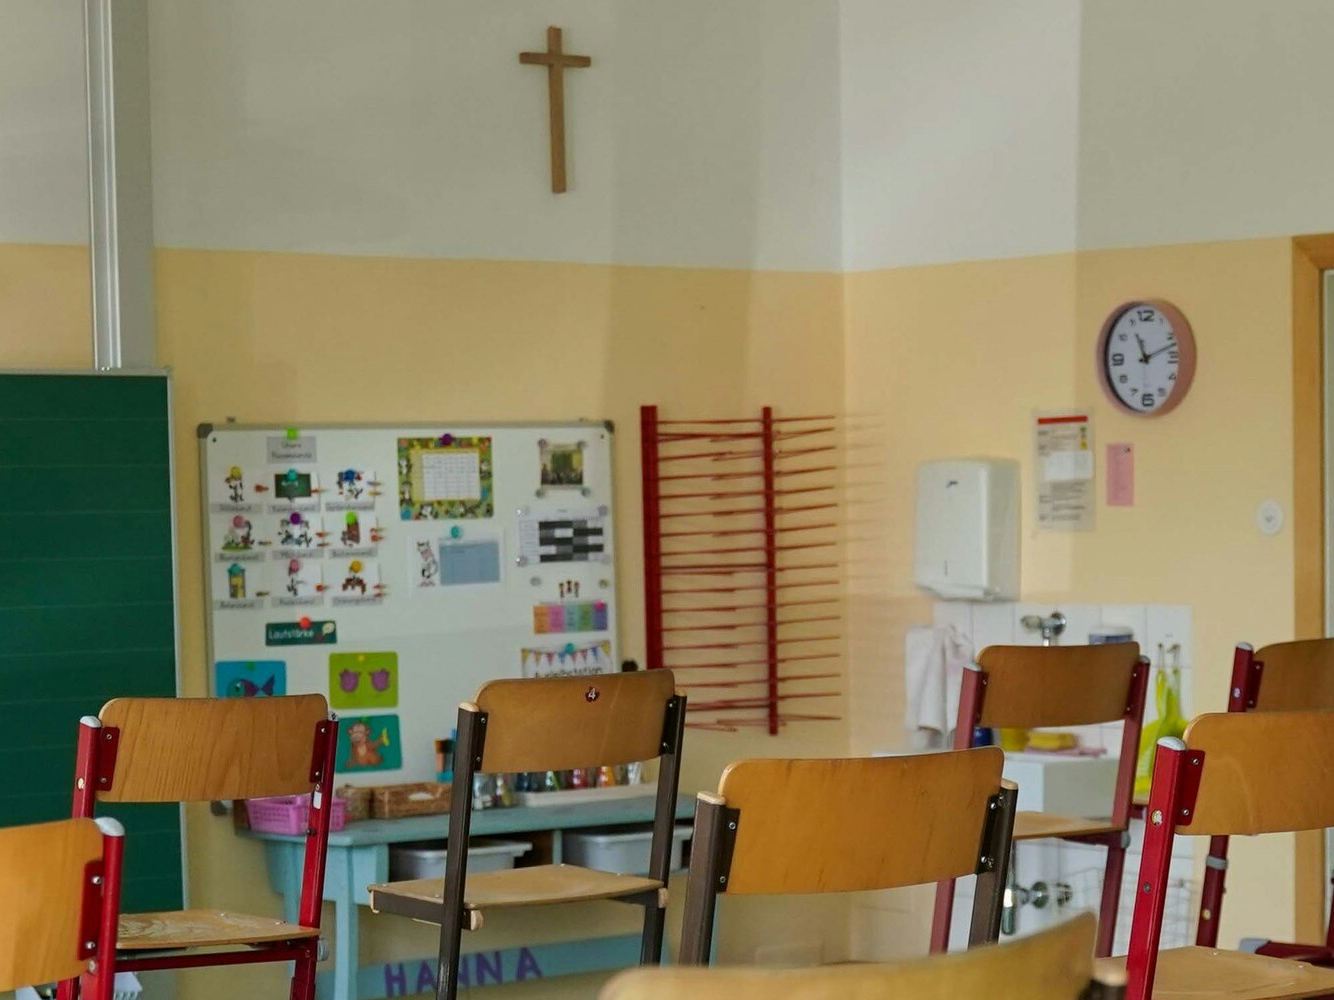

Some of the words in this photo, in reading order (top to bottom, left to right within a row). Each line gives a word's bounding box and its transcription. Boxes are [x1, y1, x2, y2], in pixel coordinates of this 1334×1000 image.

[1137, 310, 1155, 322] 12
[1112, 353, 1124, 367] 9
[1141, 393, 1155, 407] 6
[588, 687, 596, 700] 4
